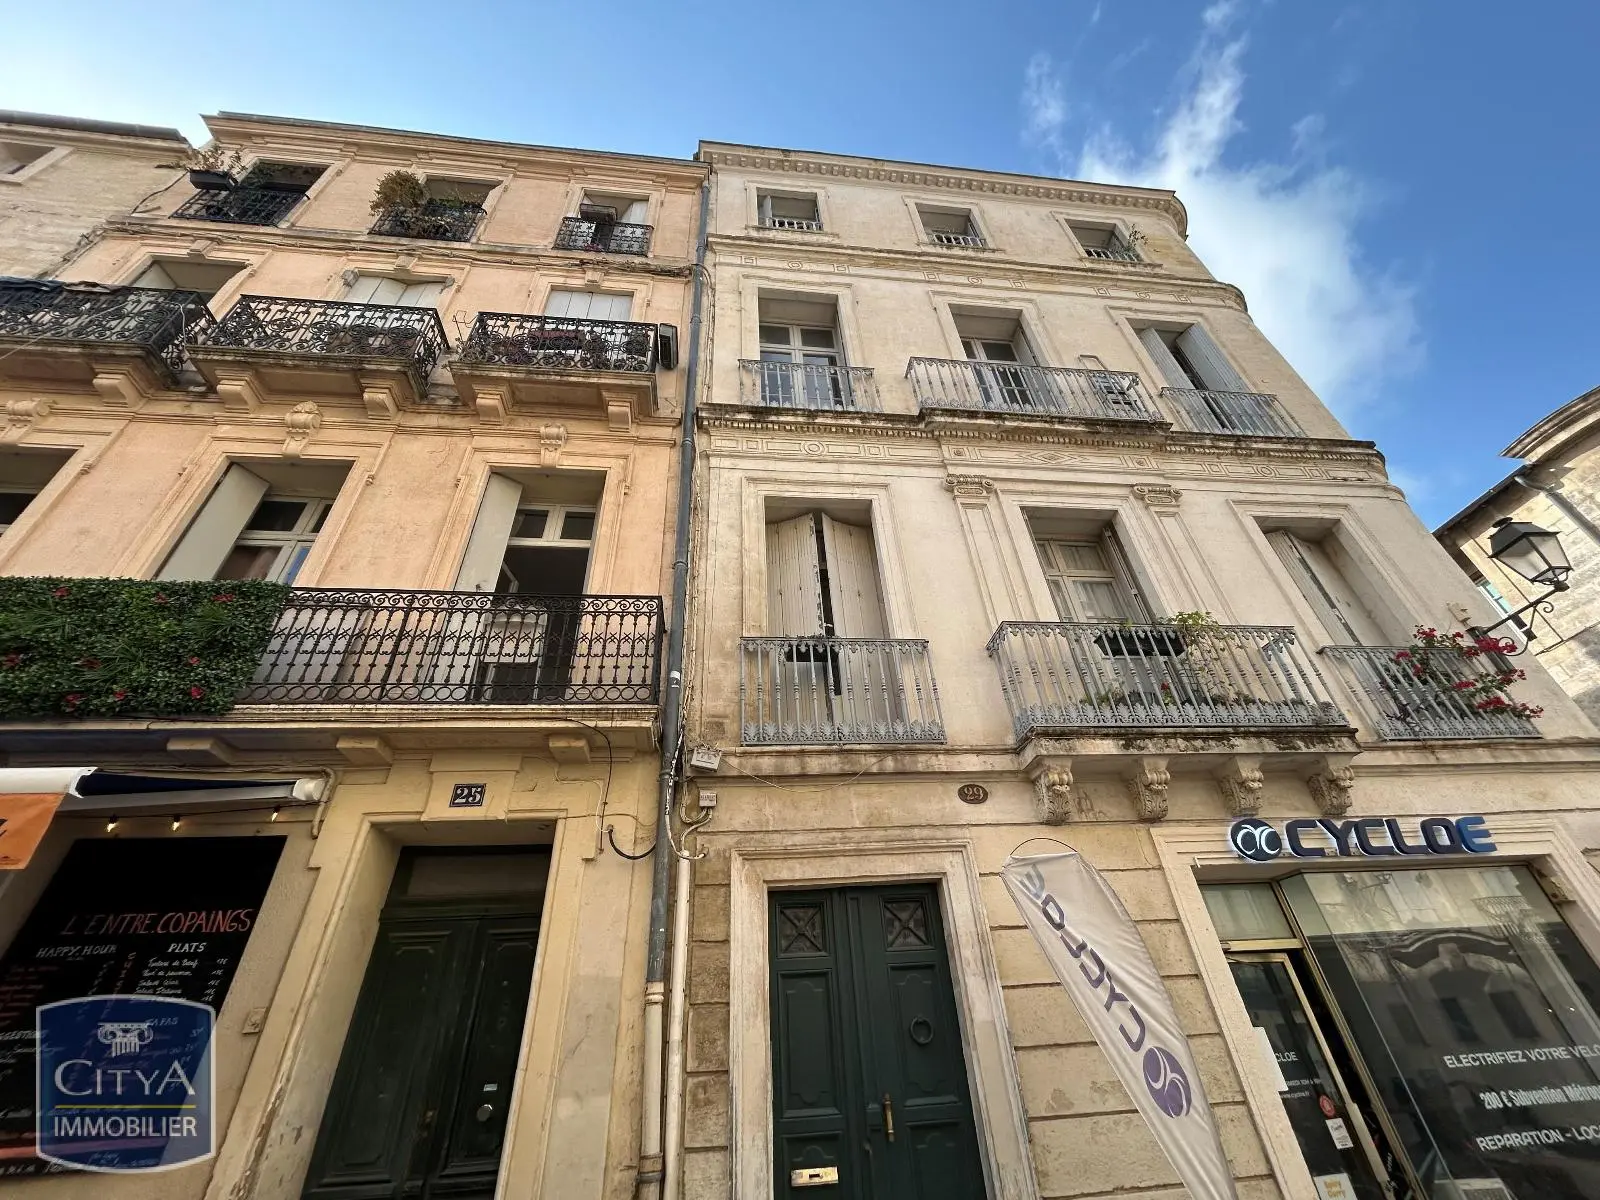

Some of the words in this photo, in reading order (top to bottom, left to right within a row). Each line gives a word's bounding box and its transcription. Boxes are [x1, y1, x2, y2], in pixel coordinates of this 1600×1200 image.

[454, 787, 482, 803] 25
[964, 786, 984, 800] 29
[1286, 816, 1498, 857] CYCLOE
[167, 942, 207, 953] PLATS
[1019, 864, 1147, 1053] CYCLOE
[1443, 1050, 1527, 1068] ELECTRIFIEZ
[1526, 1047, 1571, 1062] VOTRE
[1479, 1091, 1503, 1109] 200
[1509, 1086, 1569, 1107] Subvention
[1476, 1128, 1565, 1151] REPARATION
[1572, 1125, 1600, 1141] LOC
